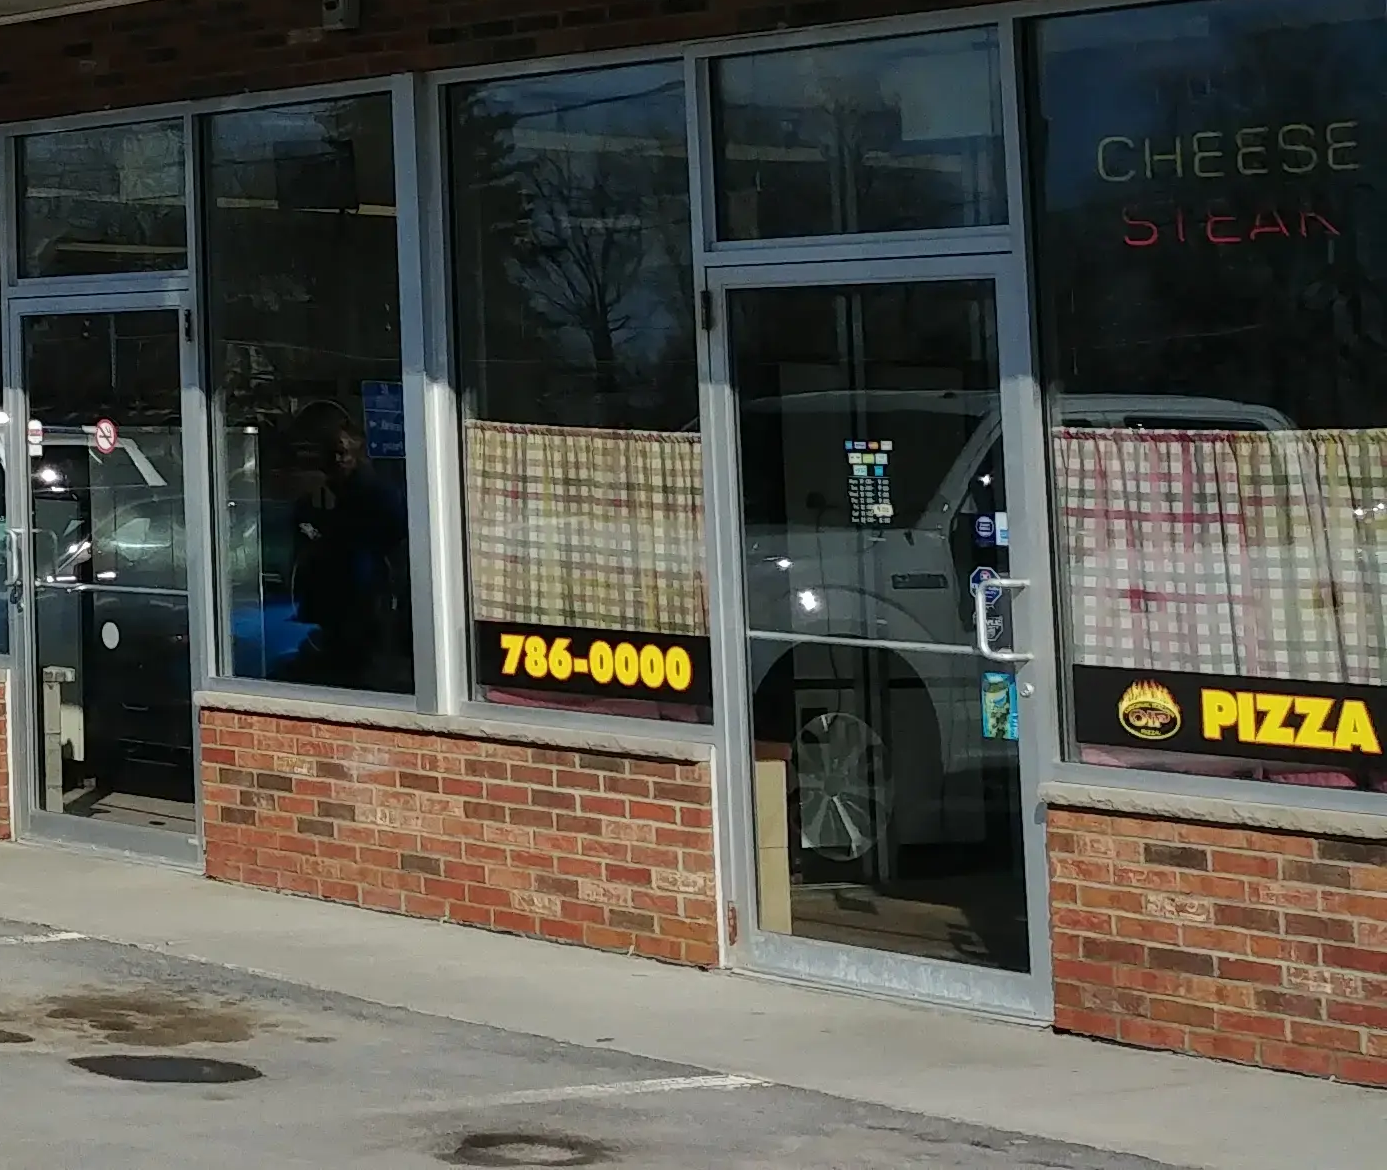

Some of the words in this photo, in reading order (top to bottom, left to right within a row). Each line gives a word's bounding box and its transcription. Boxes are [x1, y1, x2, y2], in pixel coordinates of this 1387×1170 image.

[1097, 120, 1361, 182] CHEESE
[500, 633, 692, 690] 786-0000
[1200, 687, 1384, 755] PIZZA
